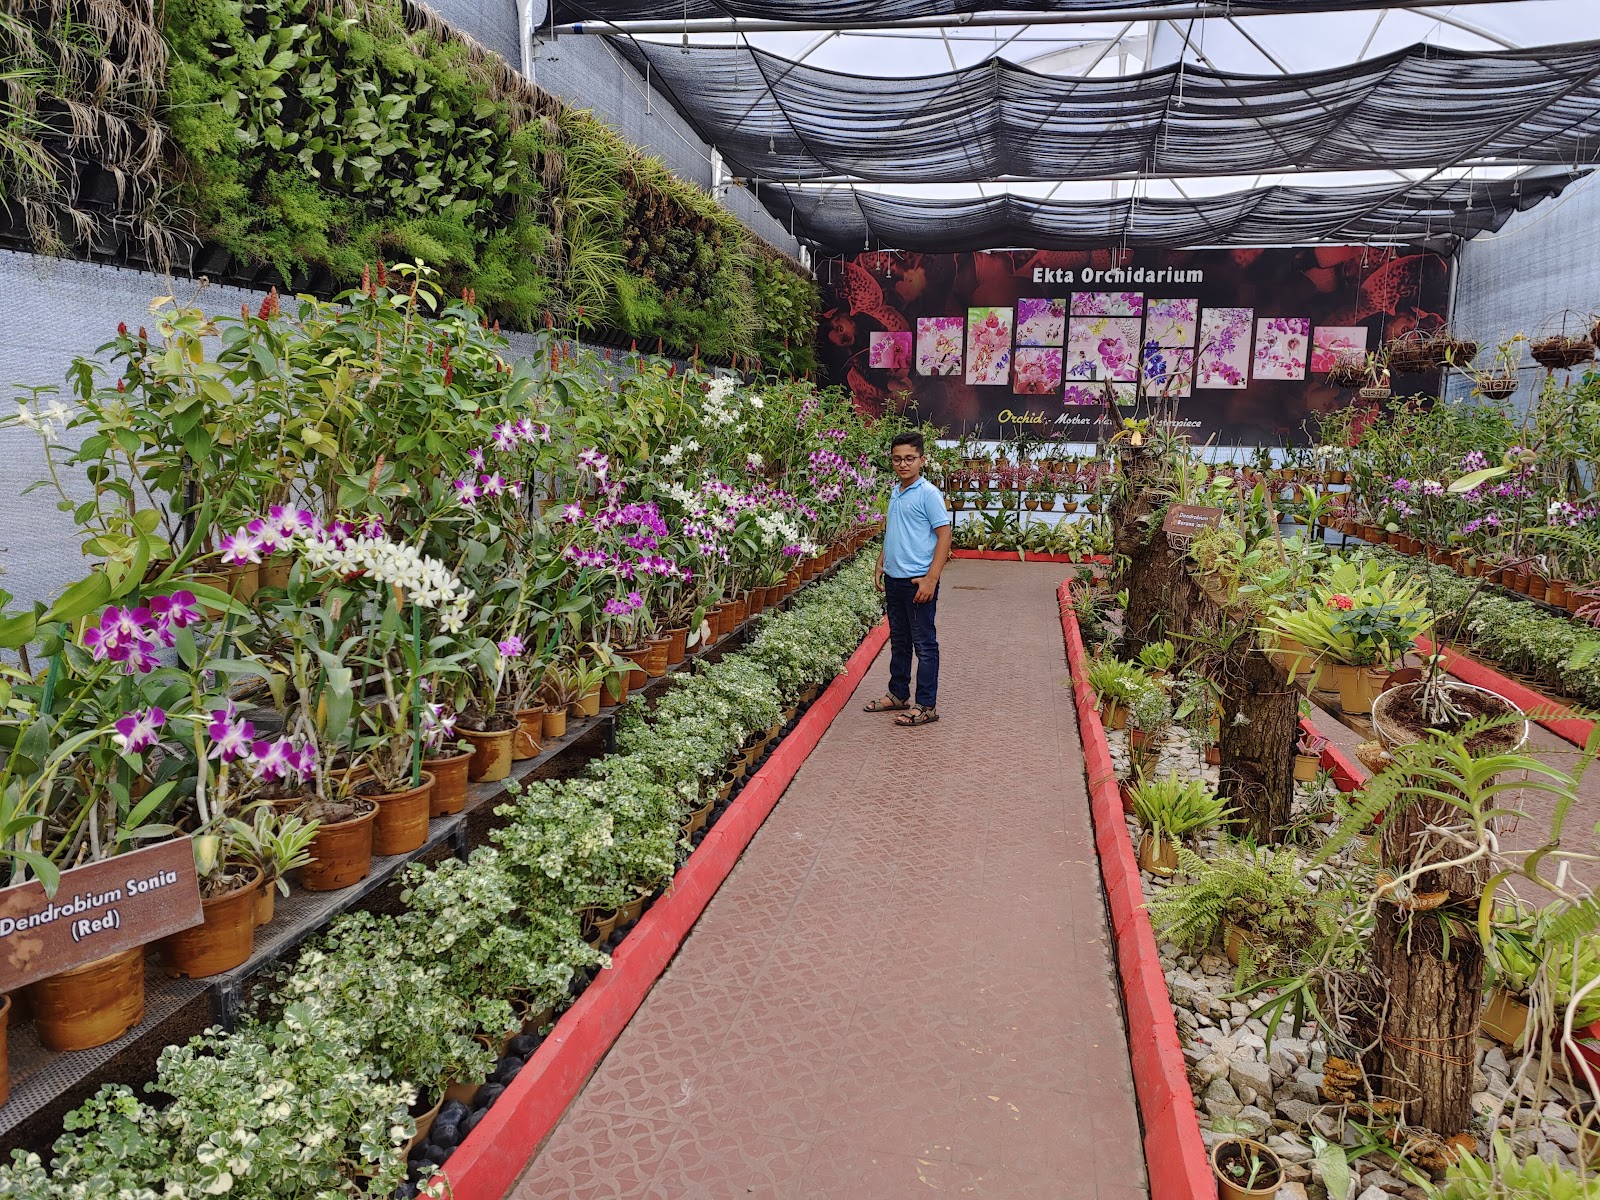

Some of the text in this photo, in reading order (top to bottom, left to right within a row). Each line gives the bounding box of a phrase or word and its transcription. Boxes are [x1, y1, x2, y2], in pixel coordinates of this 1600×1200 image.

[1033, 266, 1204, 283] Ekta Orchidarium
[1054, 413, 1090, 425] Mother
[0, 870, 178, 937] Dendrobium Sonia
[71, 909, 121, 942] (Red)
